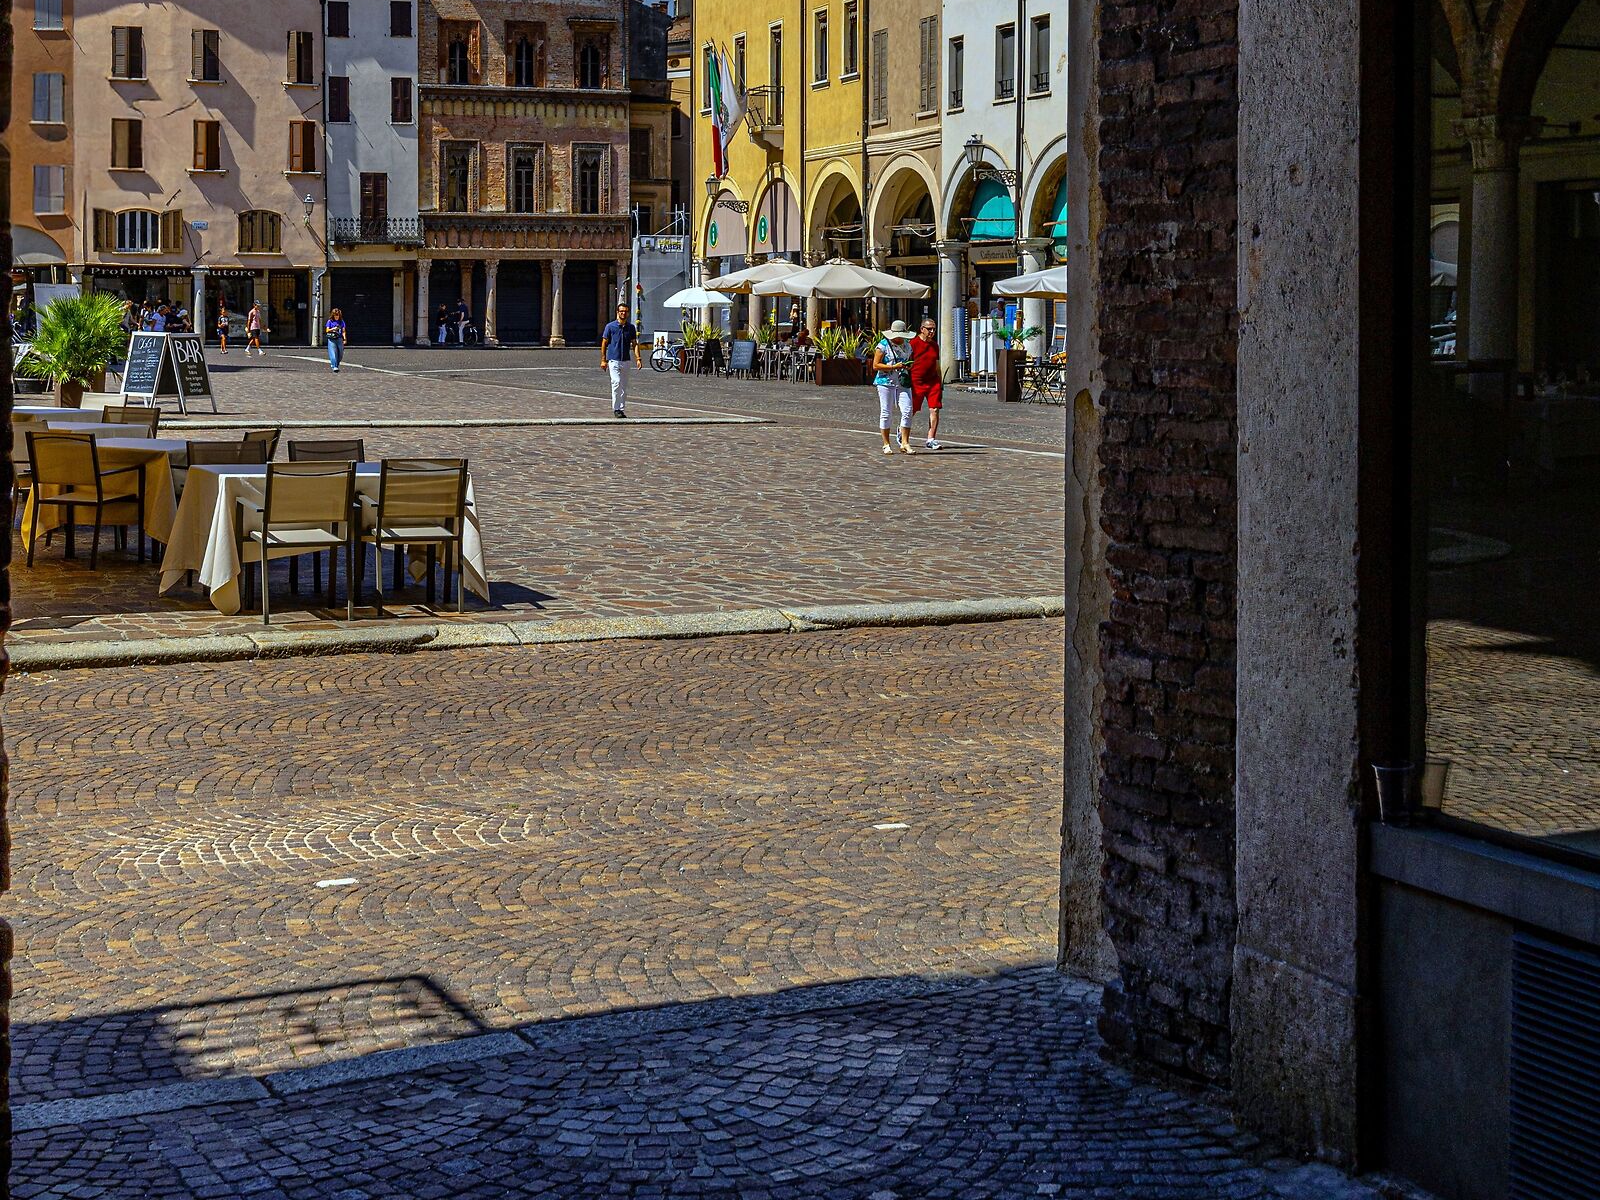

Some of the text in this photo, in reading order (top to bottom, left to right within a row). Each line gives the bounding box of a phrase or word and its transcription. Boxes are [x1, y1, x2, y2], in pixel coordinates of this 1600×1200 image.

[91, 267, 255, 277] Profumeria utore
[174, 339, 204, 364] BAR
